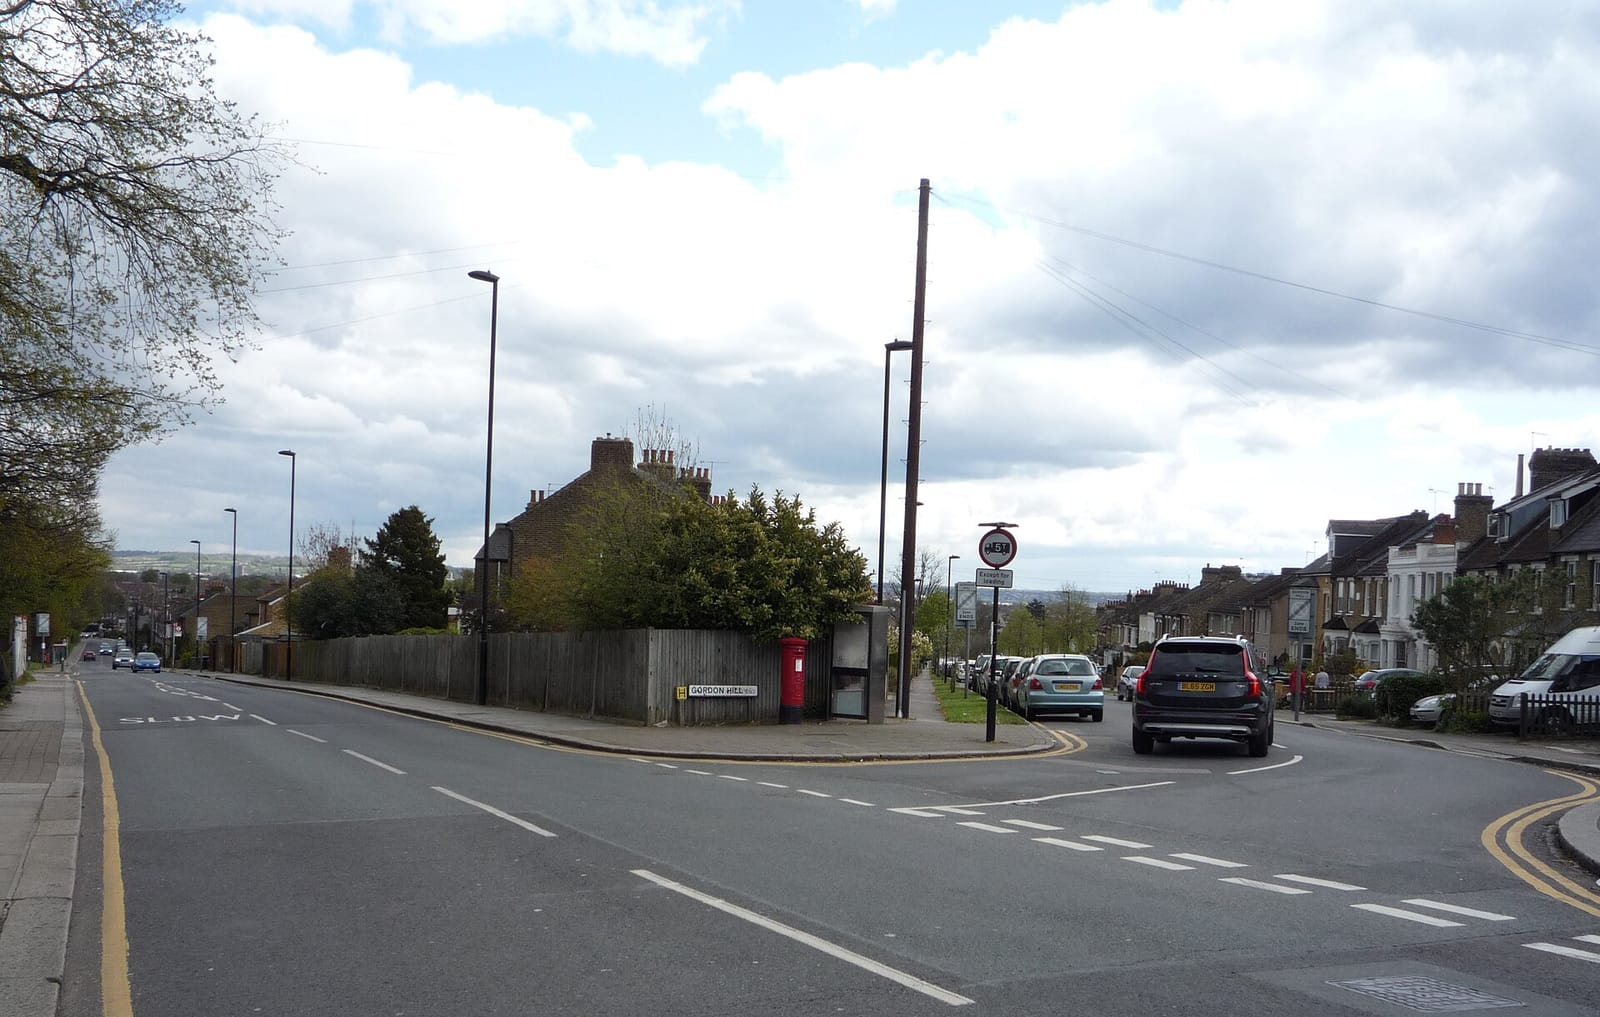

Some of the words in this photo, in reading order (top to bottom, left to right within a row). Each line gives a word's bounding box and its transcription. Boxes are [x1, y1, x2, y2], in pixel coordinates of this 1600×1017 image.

[979, 571, 1000, 579] Except
[983, 578, 1005, 586] loading
[691, 686, 725, 694] GORDON
[119, 714, 241, 724] SLOW
